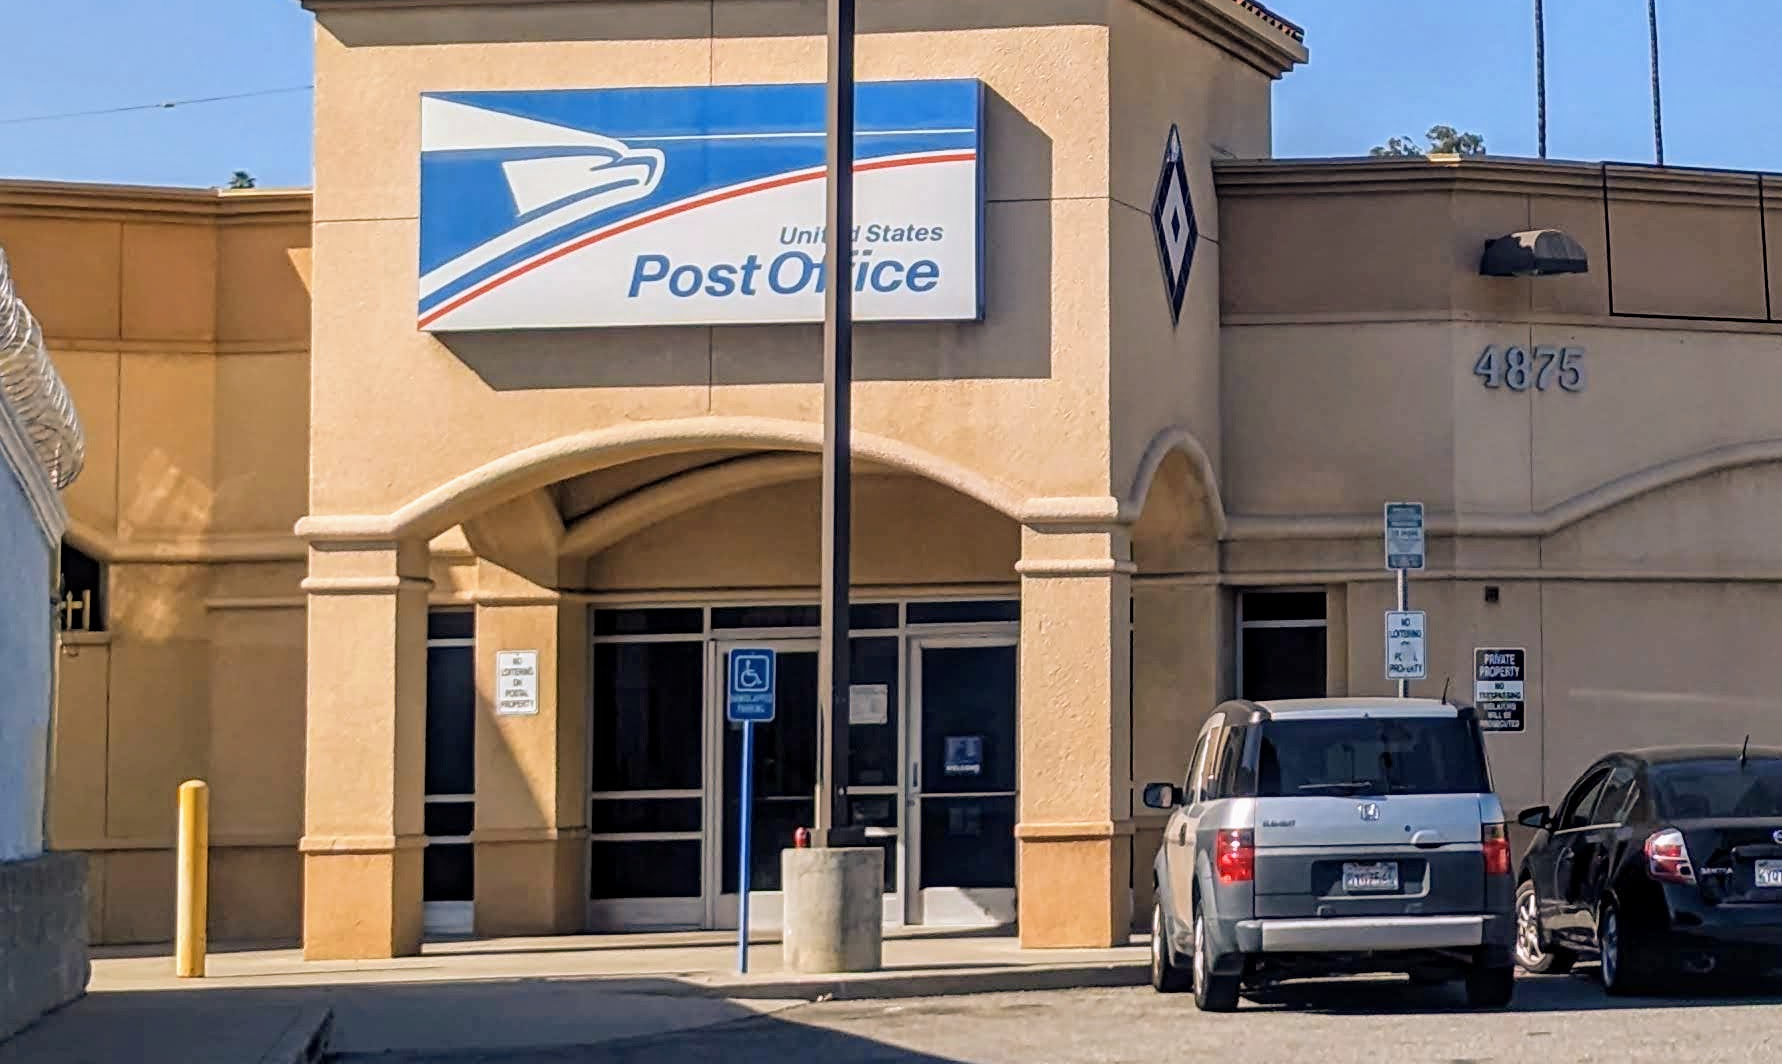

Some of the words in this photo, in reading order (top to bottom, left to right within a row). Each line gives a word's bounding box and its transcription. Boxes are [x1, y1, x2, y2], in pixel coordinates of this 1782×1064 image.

[780, 226, 860, 245] Unitd
[866, 224, 943, 242] States
[628, 253, 761, 298] Post
[768, 249, 940, 294] Ofice
[1474, 344, 1586, 392] 4875
[1484, 654, 1515, 665] PRIVATE
[1479, 666, 1519, 677] PROPERTY
